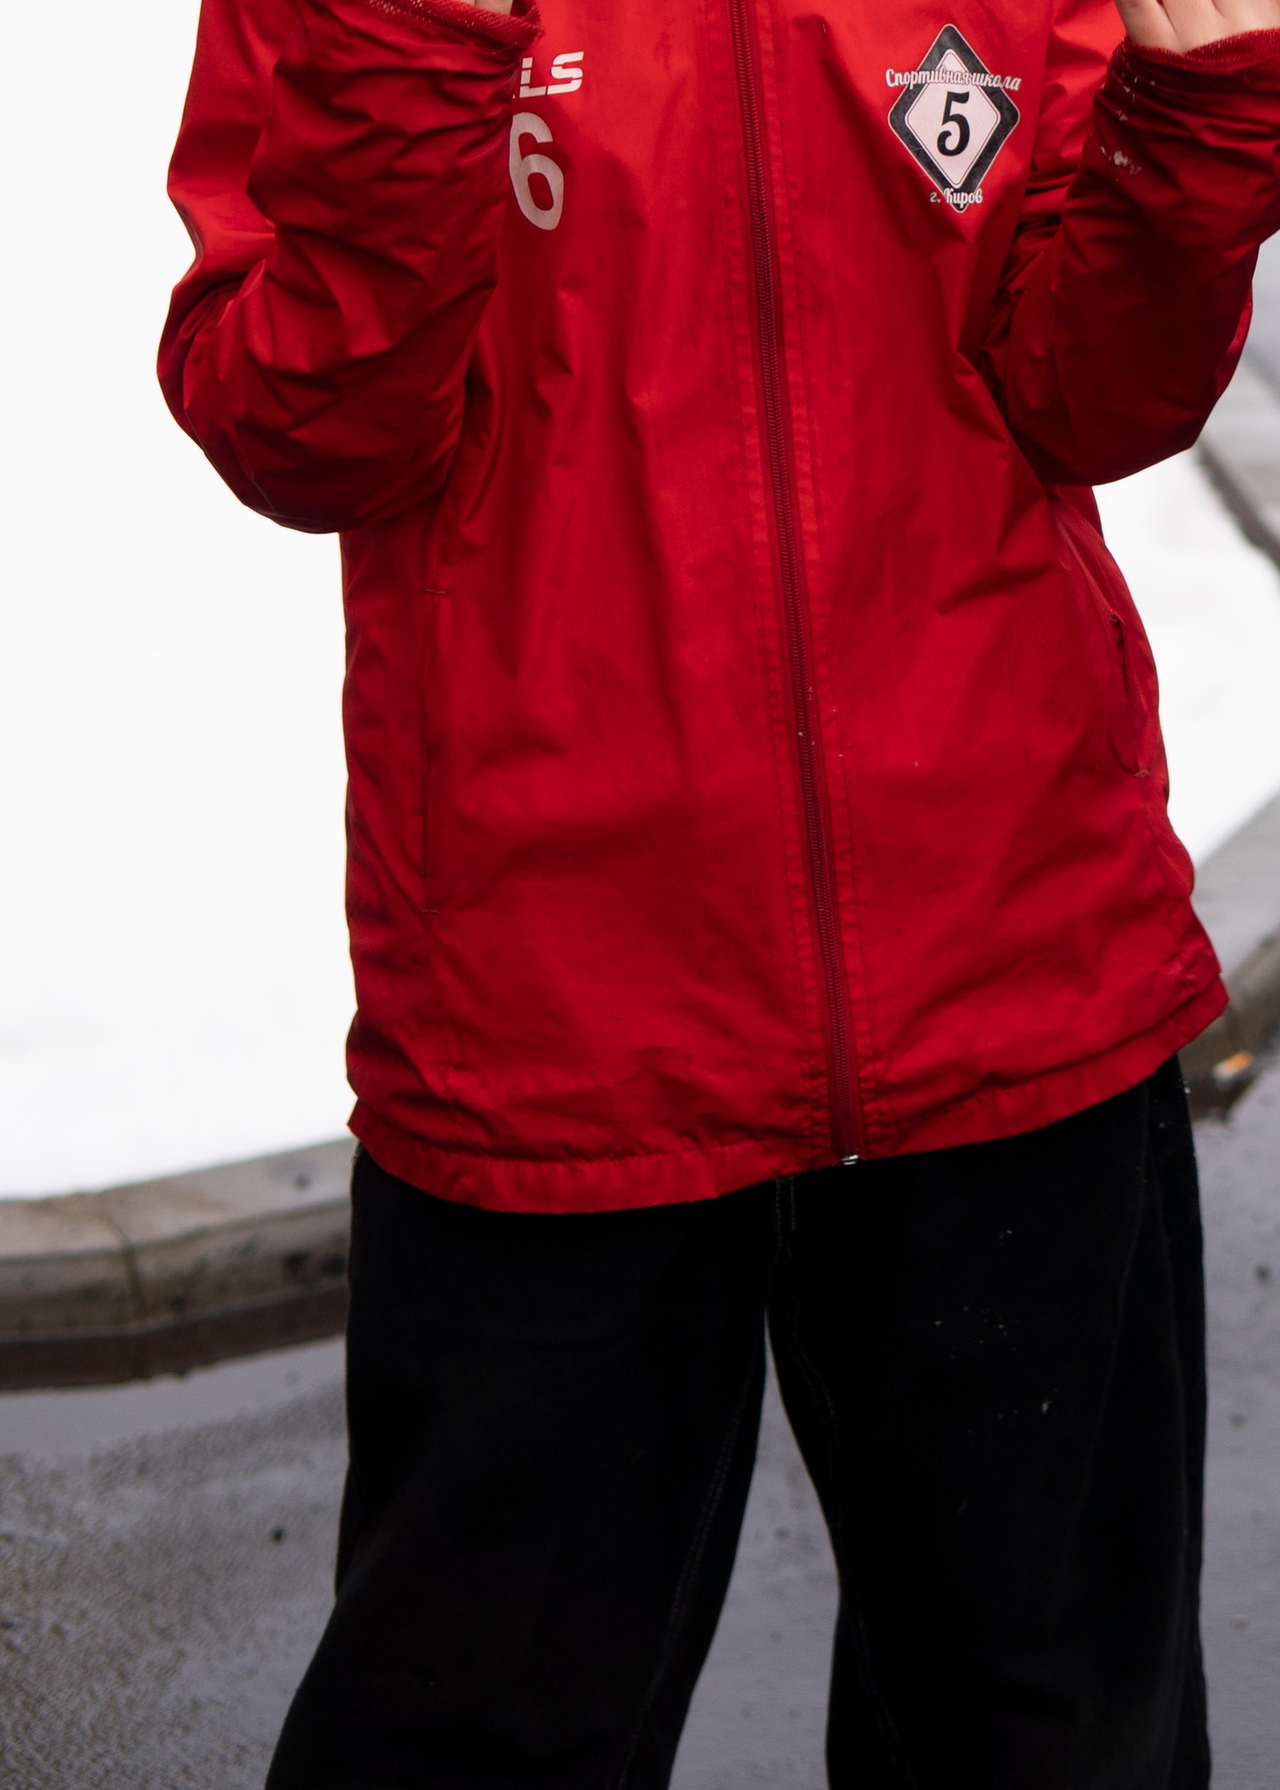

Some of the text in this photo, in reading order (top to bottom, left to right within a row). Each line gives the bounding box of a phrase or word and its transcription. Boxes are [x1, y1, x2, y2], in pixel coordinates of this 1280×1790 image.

[511, 51, 585, 100] LS
[886, 66, 1022, 91] Спортивная школа
[936, 90, 971, 157] 5
[508, 111, 565, 231] 6
[929, 188, 983, 208] г. Киров
